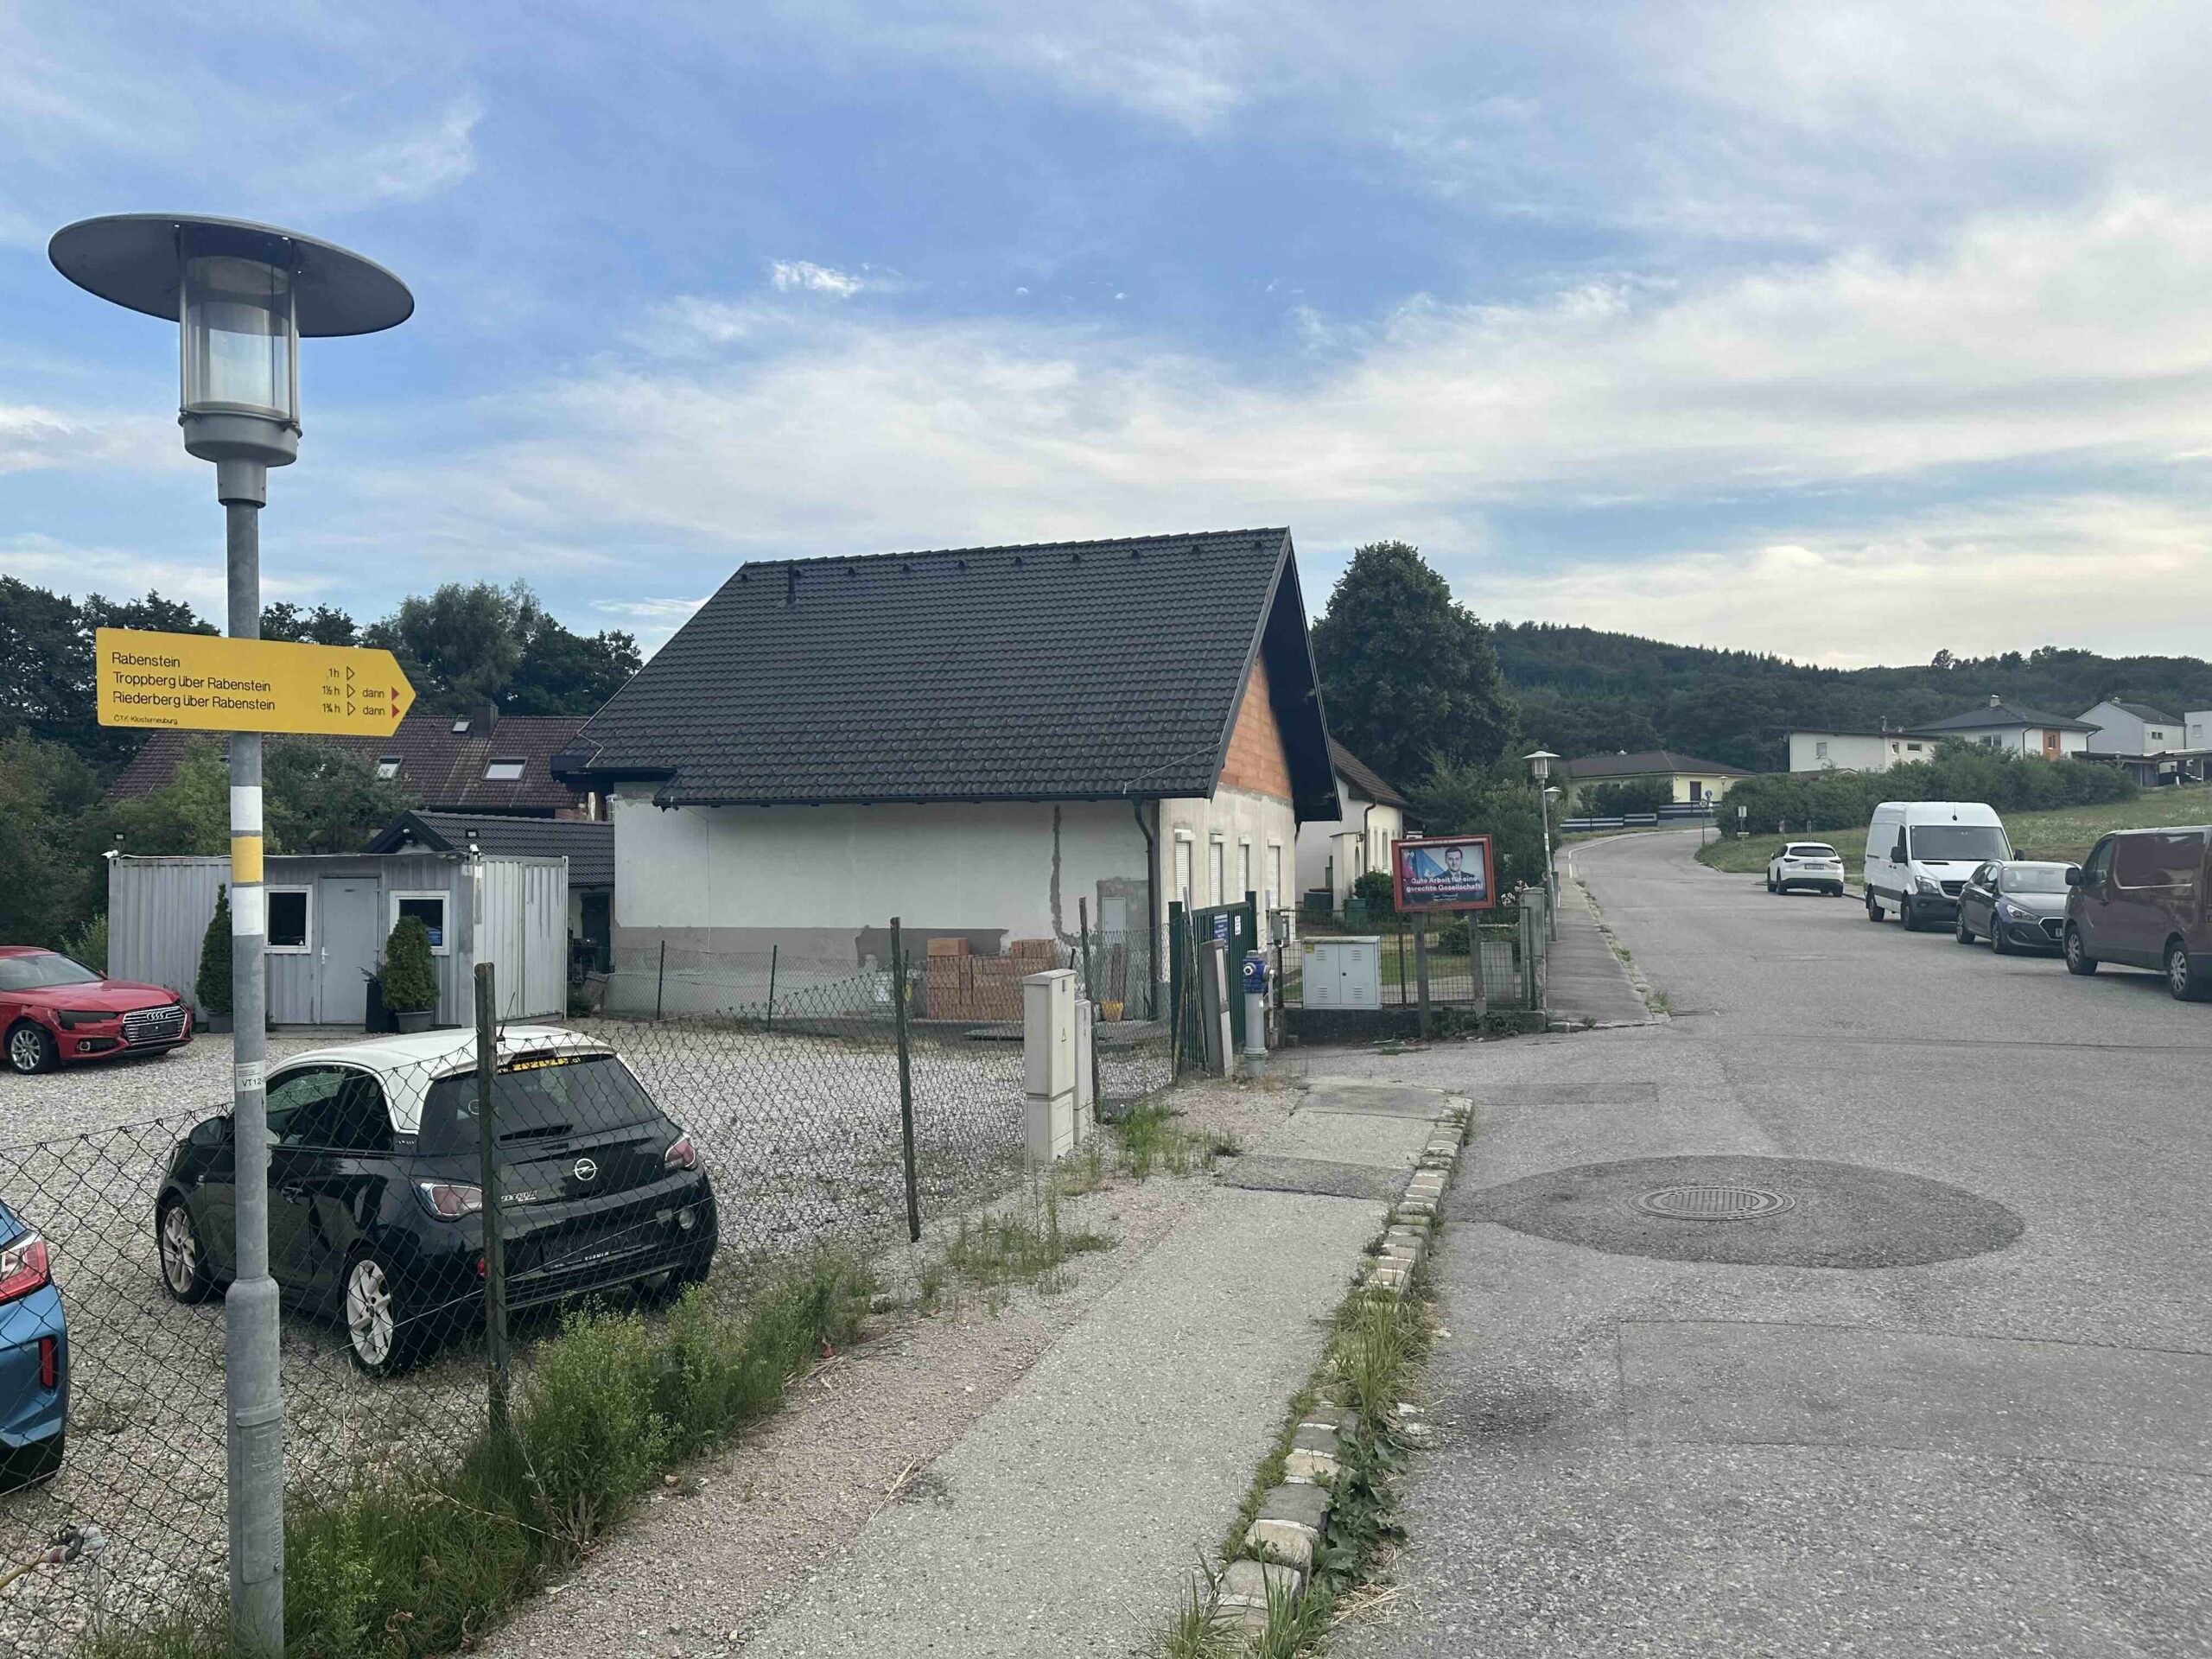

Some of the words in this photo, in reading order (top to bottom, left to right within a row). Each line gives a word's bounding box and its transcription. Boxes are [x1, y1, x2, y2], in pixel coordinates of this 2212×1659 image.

[111, 652, 180, 667] Rabenstein
[113, 671, 176, 689] Troppberg
[178, 676, 205, 688] über
[207, 677, 271, 691] Rabenstein
[362, 688, 385, 698] dann
[113, 691, 181, 708] Riederberg
[183, 695, 209, 707] über
[213, 696, 276, 710] Rabenstein
[362, 705, 385, 715] dann
